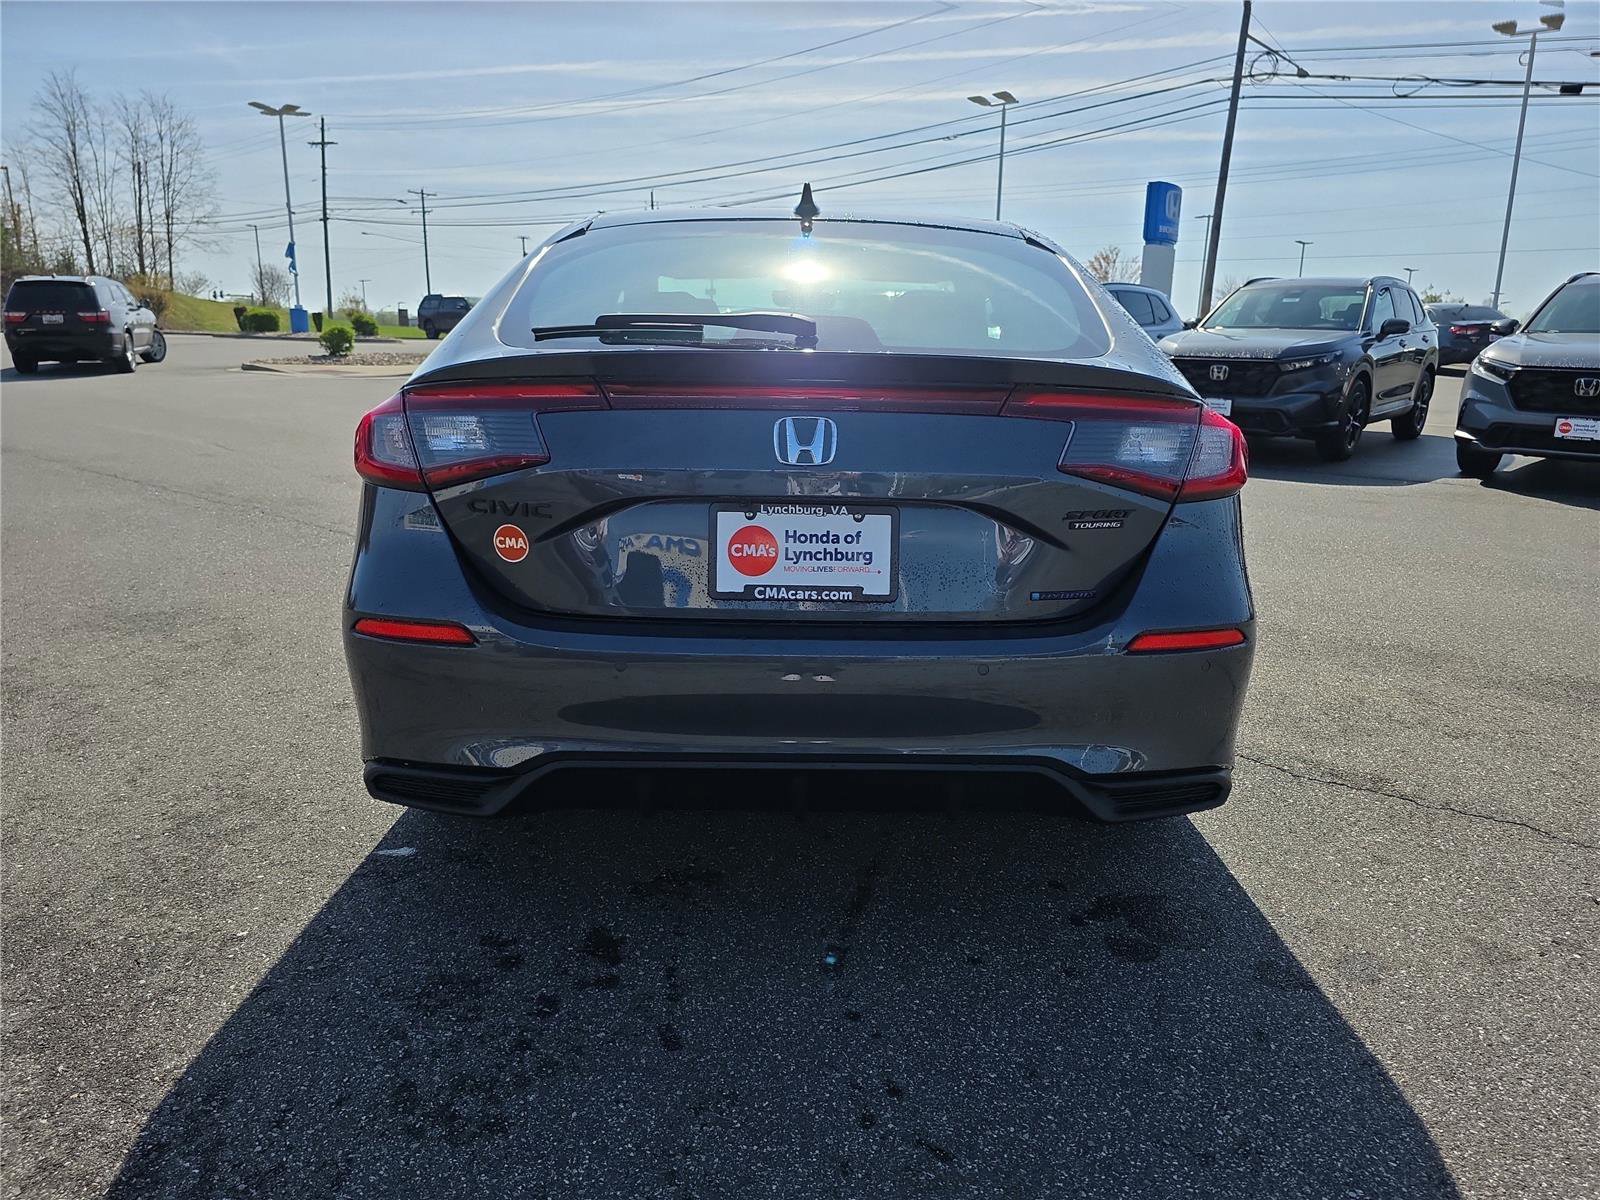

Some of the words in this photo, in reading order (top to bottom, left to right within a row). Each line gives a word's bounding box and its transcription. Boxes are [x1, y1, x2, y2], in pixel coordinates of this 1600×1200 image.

[467, 499, 552, 518] CIVIC
[760, 504, 827, 517] Lynchburg,
[830, 506, 848, 515] VA
[1062, 510, 1136, 520] SPORT
[496, 536, 527, 549] CMA
[784, 530, 838, 544] Honda
[843, 531, 862, 544] of
[730, 543, 776, 557] CMA's
[784, 547, 873, 564] Lynchburg
[754, 587, 853, 600] CMAcars.com
